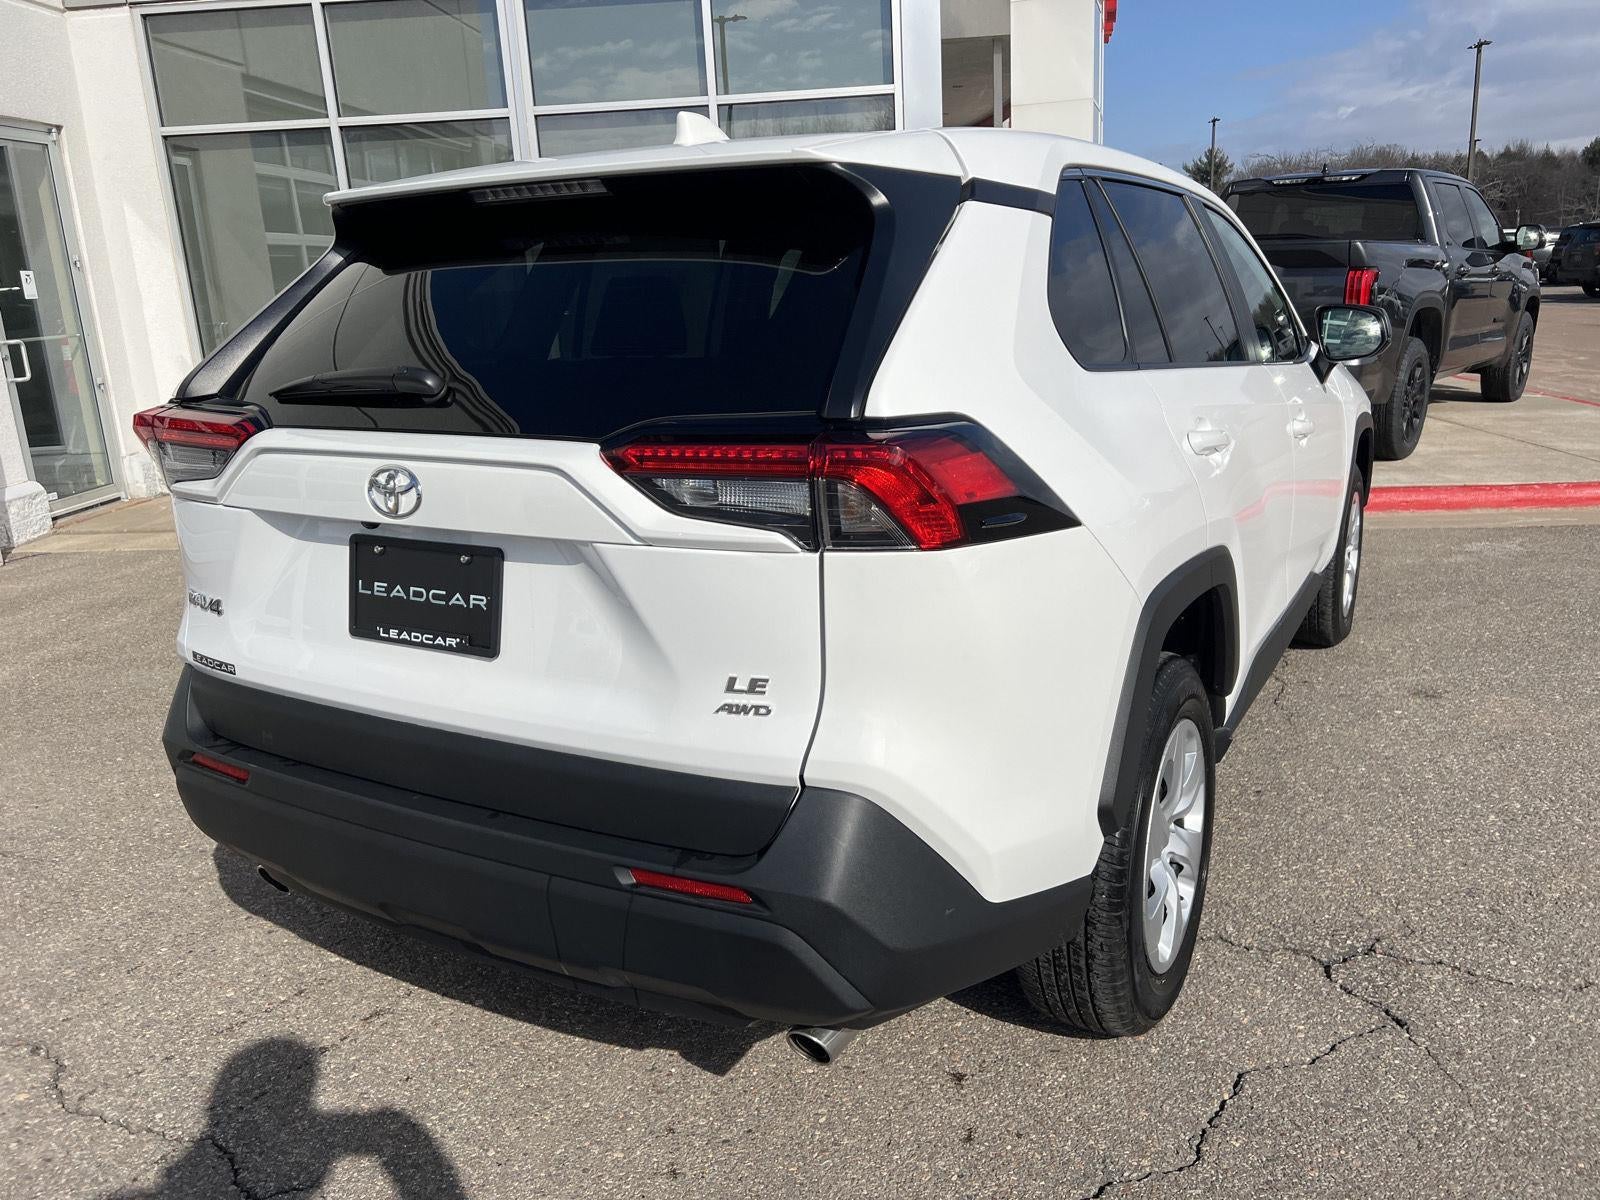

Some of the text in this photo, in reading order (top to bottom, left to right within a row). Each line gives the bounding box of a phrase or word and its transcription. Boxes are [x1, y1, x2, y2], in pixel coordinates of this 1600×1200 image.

[358, 579, 488, 611] LEADCAR
[723, 676, 770, 696] LE
[712, 702, 772, 717] AWD
